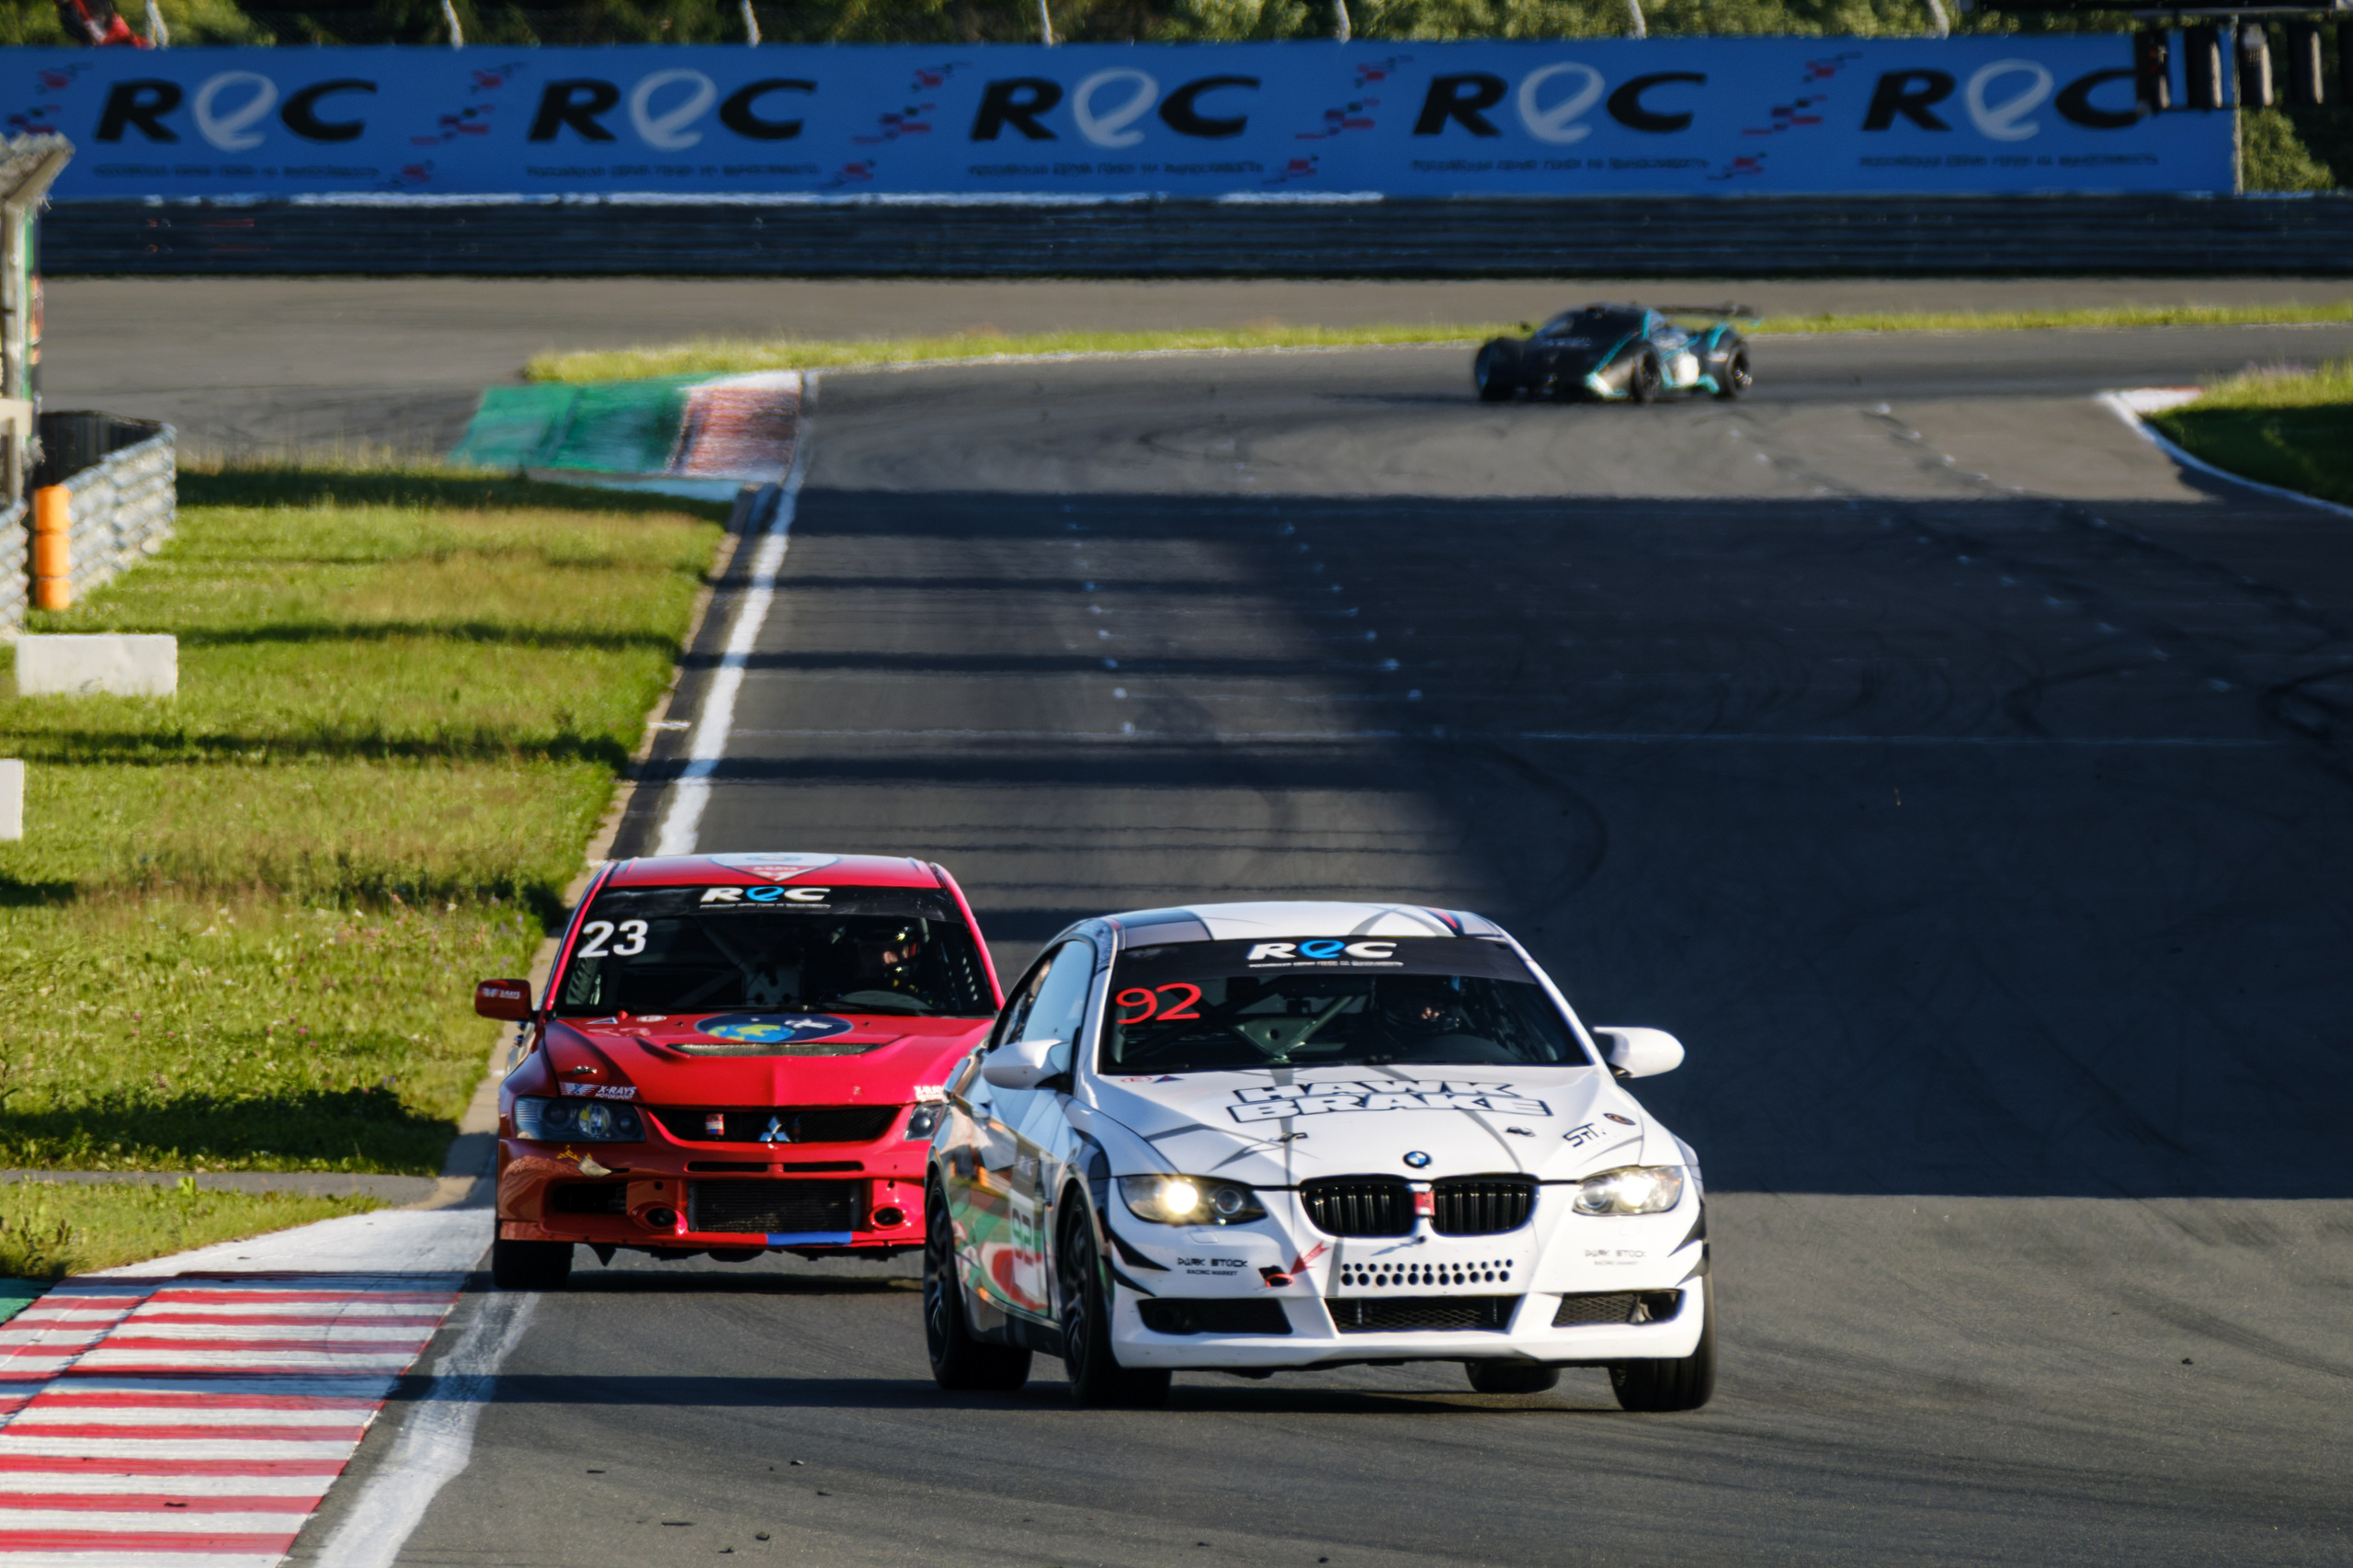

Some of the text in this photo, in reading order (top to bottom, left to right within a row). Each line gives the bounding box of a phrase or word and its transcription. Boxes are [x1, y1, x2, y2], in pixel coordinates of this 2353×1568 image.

[577, 919, 648, 959] 23
[1115, 983, 1201, 1025] 92
[598, 1085, 637, 1096] X-RAYS
[1233, 1079, 1522, 1103] HAWK
[1226, 1094, 1553, 1123] BRAKE
[1211, 1257, 1248, 1267] STOCK
